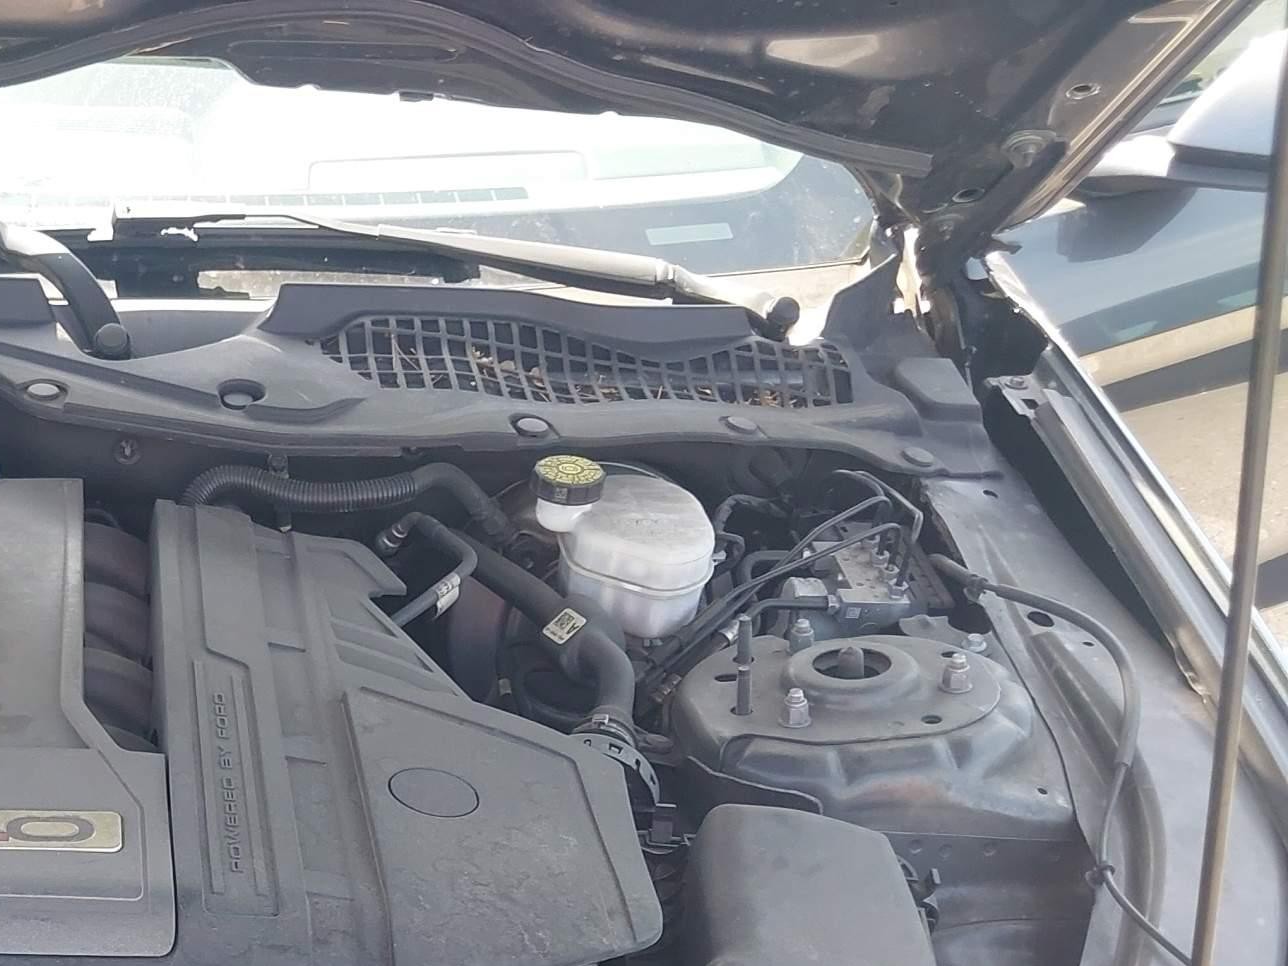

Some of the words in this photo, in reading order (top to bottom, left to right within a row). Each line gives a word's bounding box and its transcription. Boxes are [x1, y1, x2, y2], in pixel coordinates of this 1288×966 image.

[213, 692, 230, 740] FORD
[218, 746, 233, 770] BY
[222, 776, 244, 874] POWERED
